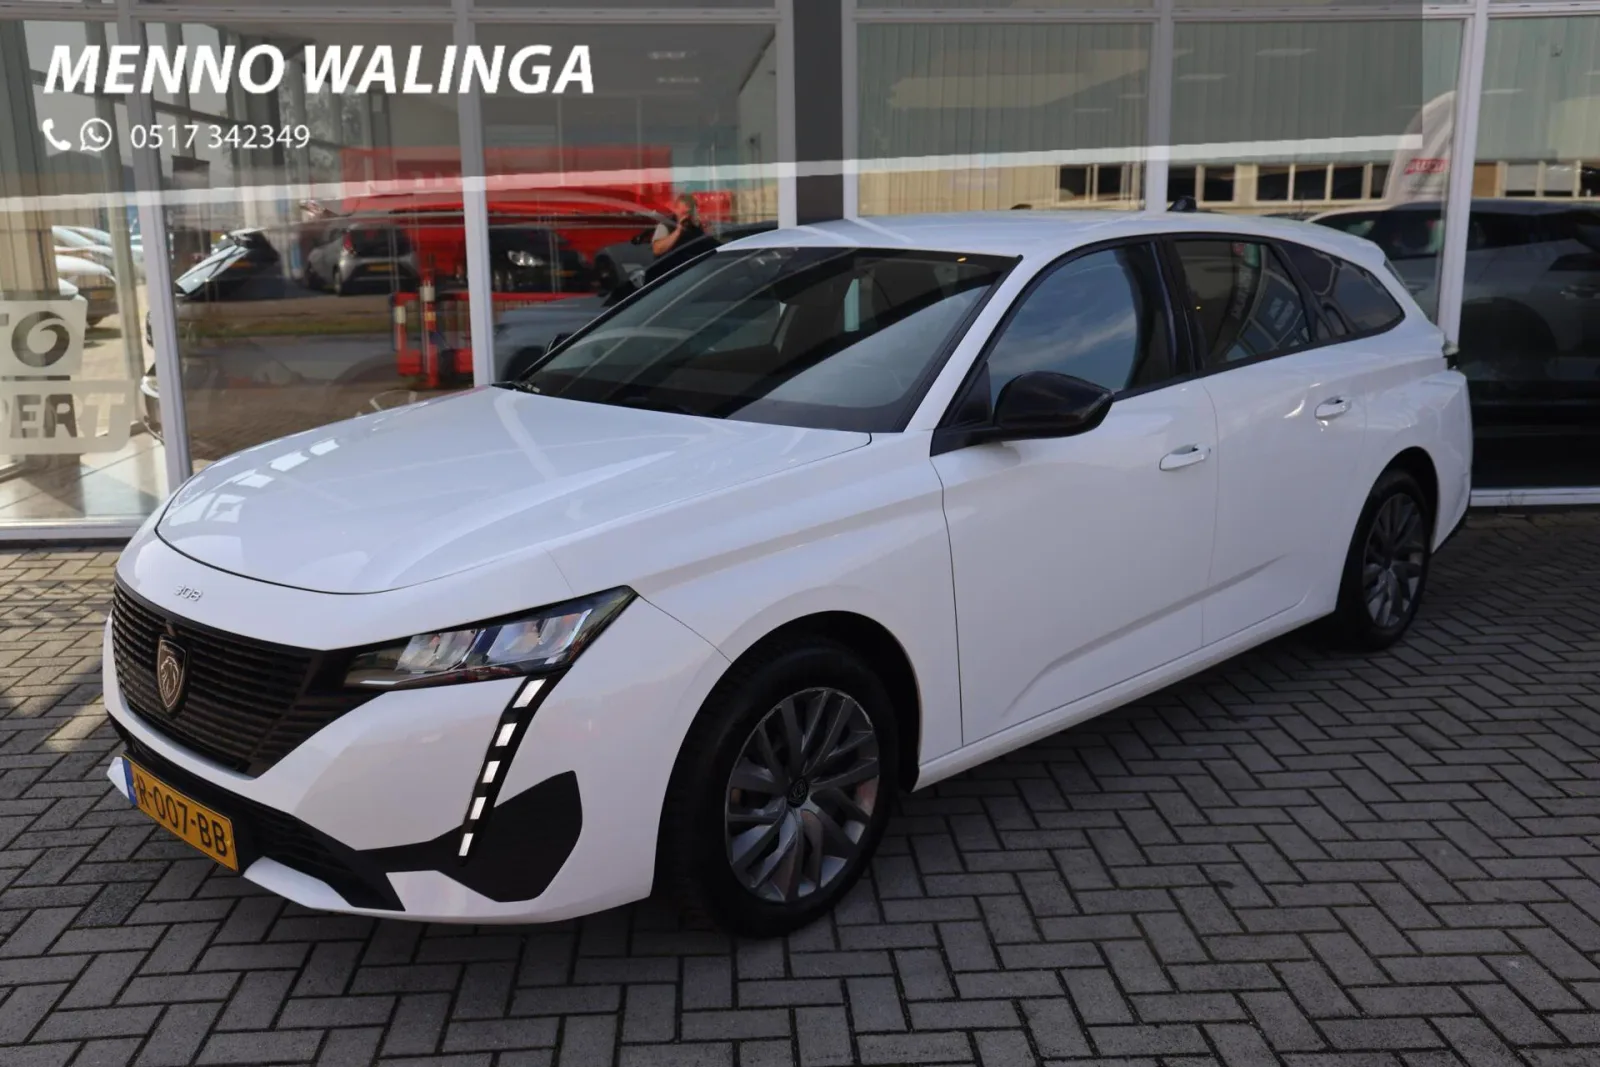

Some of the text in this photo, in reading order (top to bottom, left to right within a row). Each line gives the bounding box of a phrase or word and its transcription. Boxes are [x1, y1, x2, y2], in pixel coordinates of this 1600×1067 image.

[0, 393, 126, 438] ERT
[174, 584, 203, 602] 308
[136, 773, 228, 857] R-007-BB
